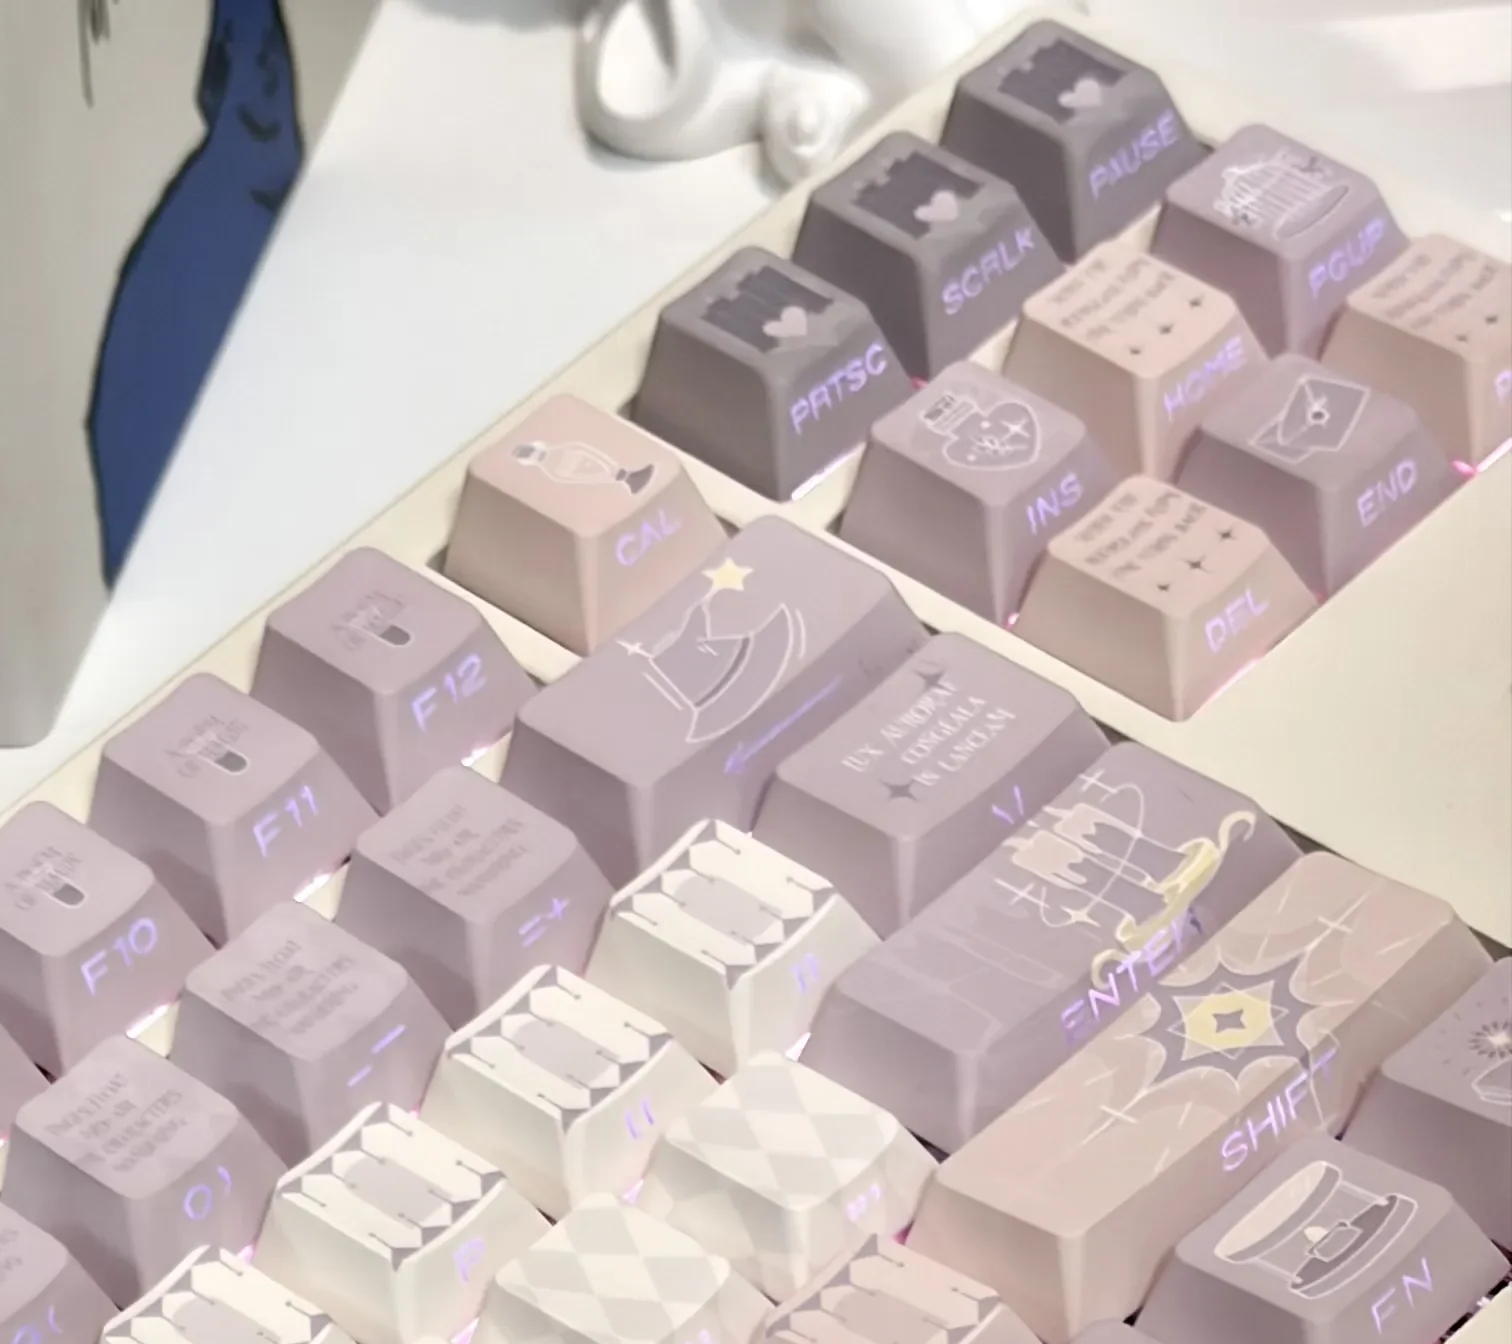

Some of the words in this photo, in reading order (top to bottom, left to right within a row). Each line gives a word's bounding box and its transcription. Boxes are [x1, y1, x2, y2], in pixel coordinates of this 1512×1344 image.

[1088, 108, 1179, 201] PAUSE
[941, 226, 1036, 315] SCRLK
[1308, 216, 1386, 297] PGUP
[789, 342, 888, 434] PRTSC
[1162, 335, 1247, 421] HOME
[1025, 470, 1084, 535] INS
[1356, 457, 1418, 527] END
[614, 508, 681, 568] CAL
[1202, 586, 1271, 653] DEL
[410, 653, 486, 731] F12
[252, 785, 320, 858] F11
[80, 916, 157, 997] F10
[1059, 907, 1204, 1046] ENTER
[1219, 1047, 1339, 1173] SHIFT
[1370, 1256, 1434, 1335] FN
